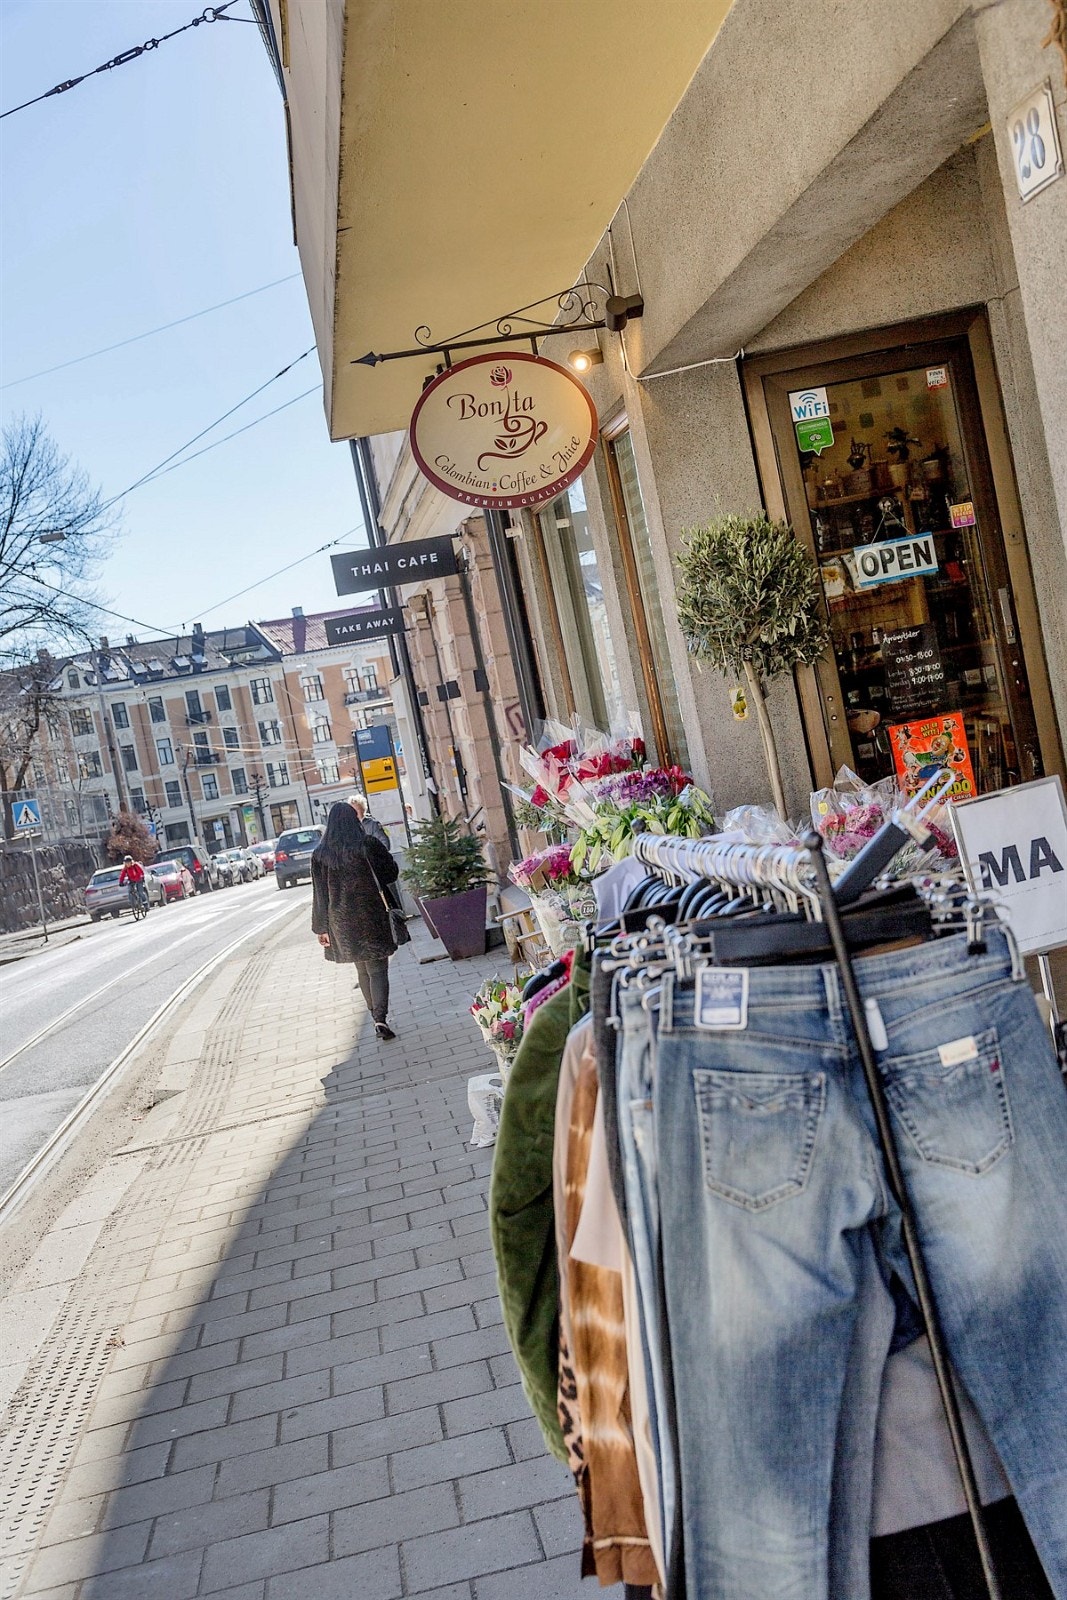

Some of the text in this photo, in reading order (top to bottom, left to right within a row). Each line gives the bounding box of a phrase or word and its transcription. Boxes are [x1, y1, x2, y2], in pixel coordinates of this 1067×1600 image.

[1013, 107, 1046, 182] 28
[446, 387, 536, 421] Bonita
[793, 401, 828, 419] WiFi
[434, 435, 581, 493] Colombian Coffee & Juice
[457, 476, 570, 507] PREMIUM QUALITY
[350, 552, 439, 577] THAI CAFE
[860, 540, 934, 578] OPEN
[334, 617, 395, 635] TAKE AWAY
[978, 836, 1065, 890] MA
